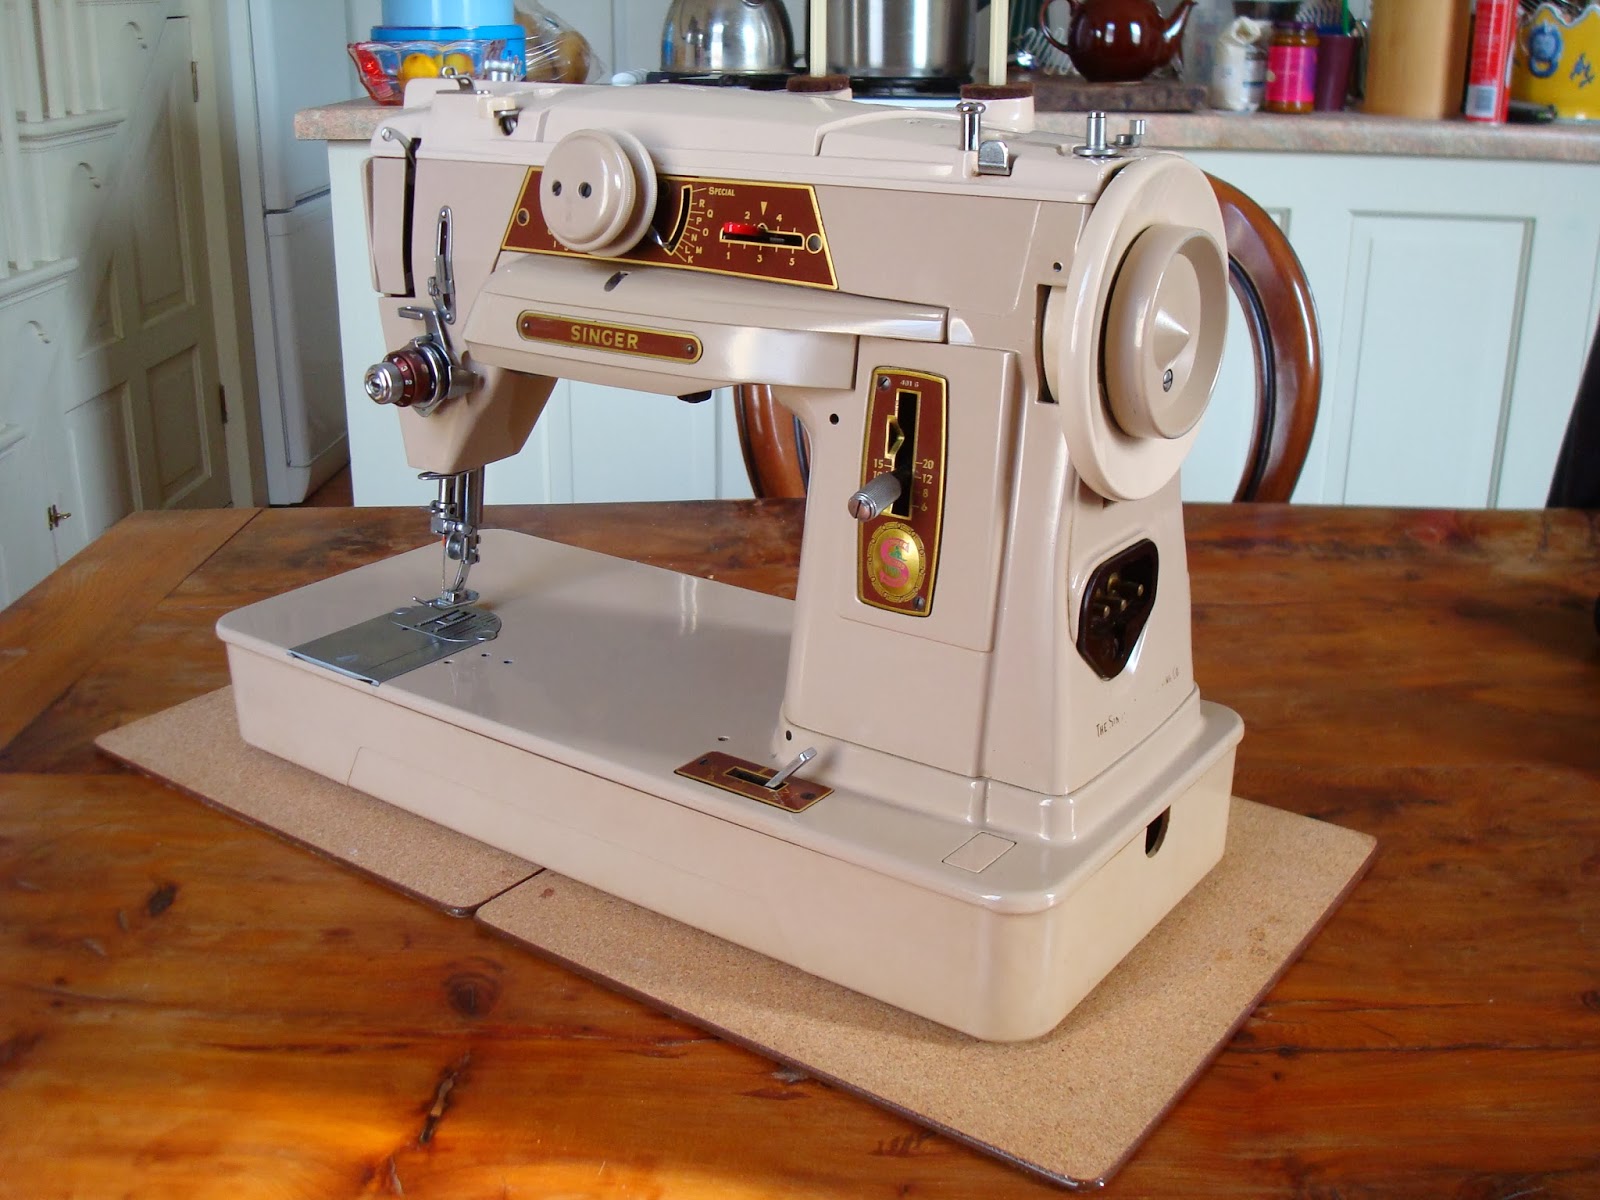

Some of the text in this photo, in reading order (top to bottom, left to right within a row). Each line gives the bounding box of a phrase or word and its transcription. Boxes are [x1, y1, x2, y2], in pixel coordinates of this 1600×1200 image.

[708, 186, 735, 197] SPECIAL
[699, 199, 705, 208] R
[707, 209, 714, 218] Q
[744, 211, 751, 220] 2
[776, 214, 783, 222] 4
[696, 217, 702, 225] P
[691, 234, 698, 242] N
[685, 245, 691, 254] L
[695, 246, 703, 254] M
[687, 255, 694, 264] K
[726, 251, 731, 260] 1
[757, 254, 763, 263] 3
[789, 257, 795, 266] 5
[570, 324, 639, 350] SINGER
[873, 458, 884, 469] 15
[922, 458, 935, 470] 20
[922, 473, 933, 485] 12
[922, 488, 929, 498] 8
[921, 503, 928, 512] 6
